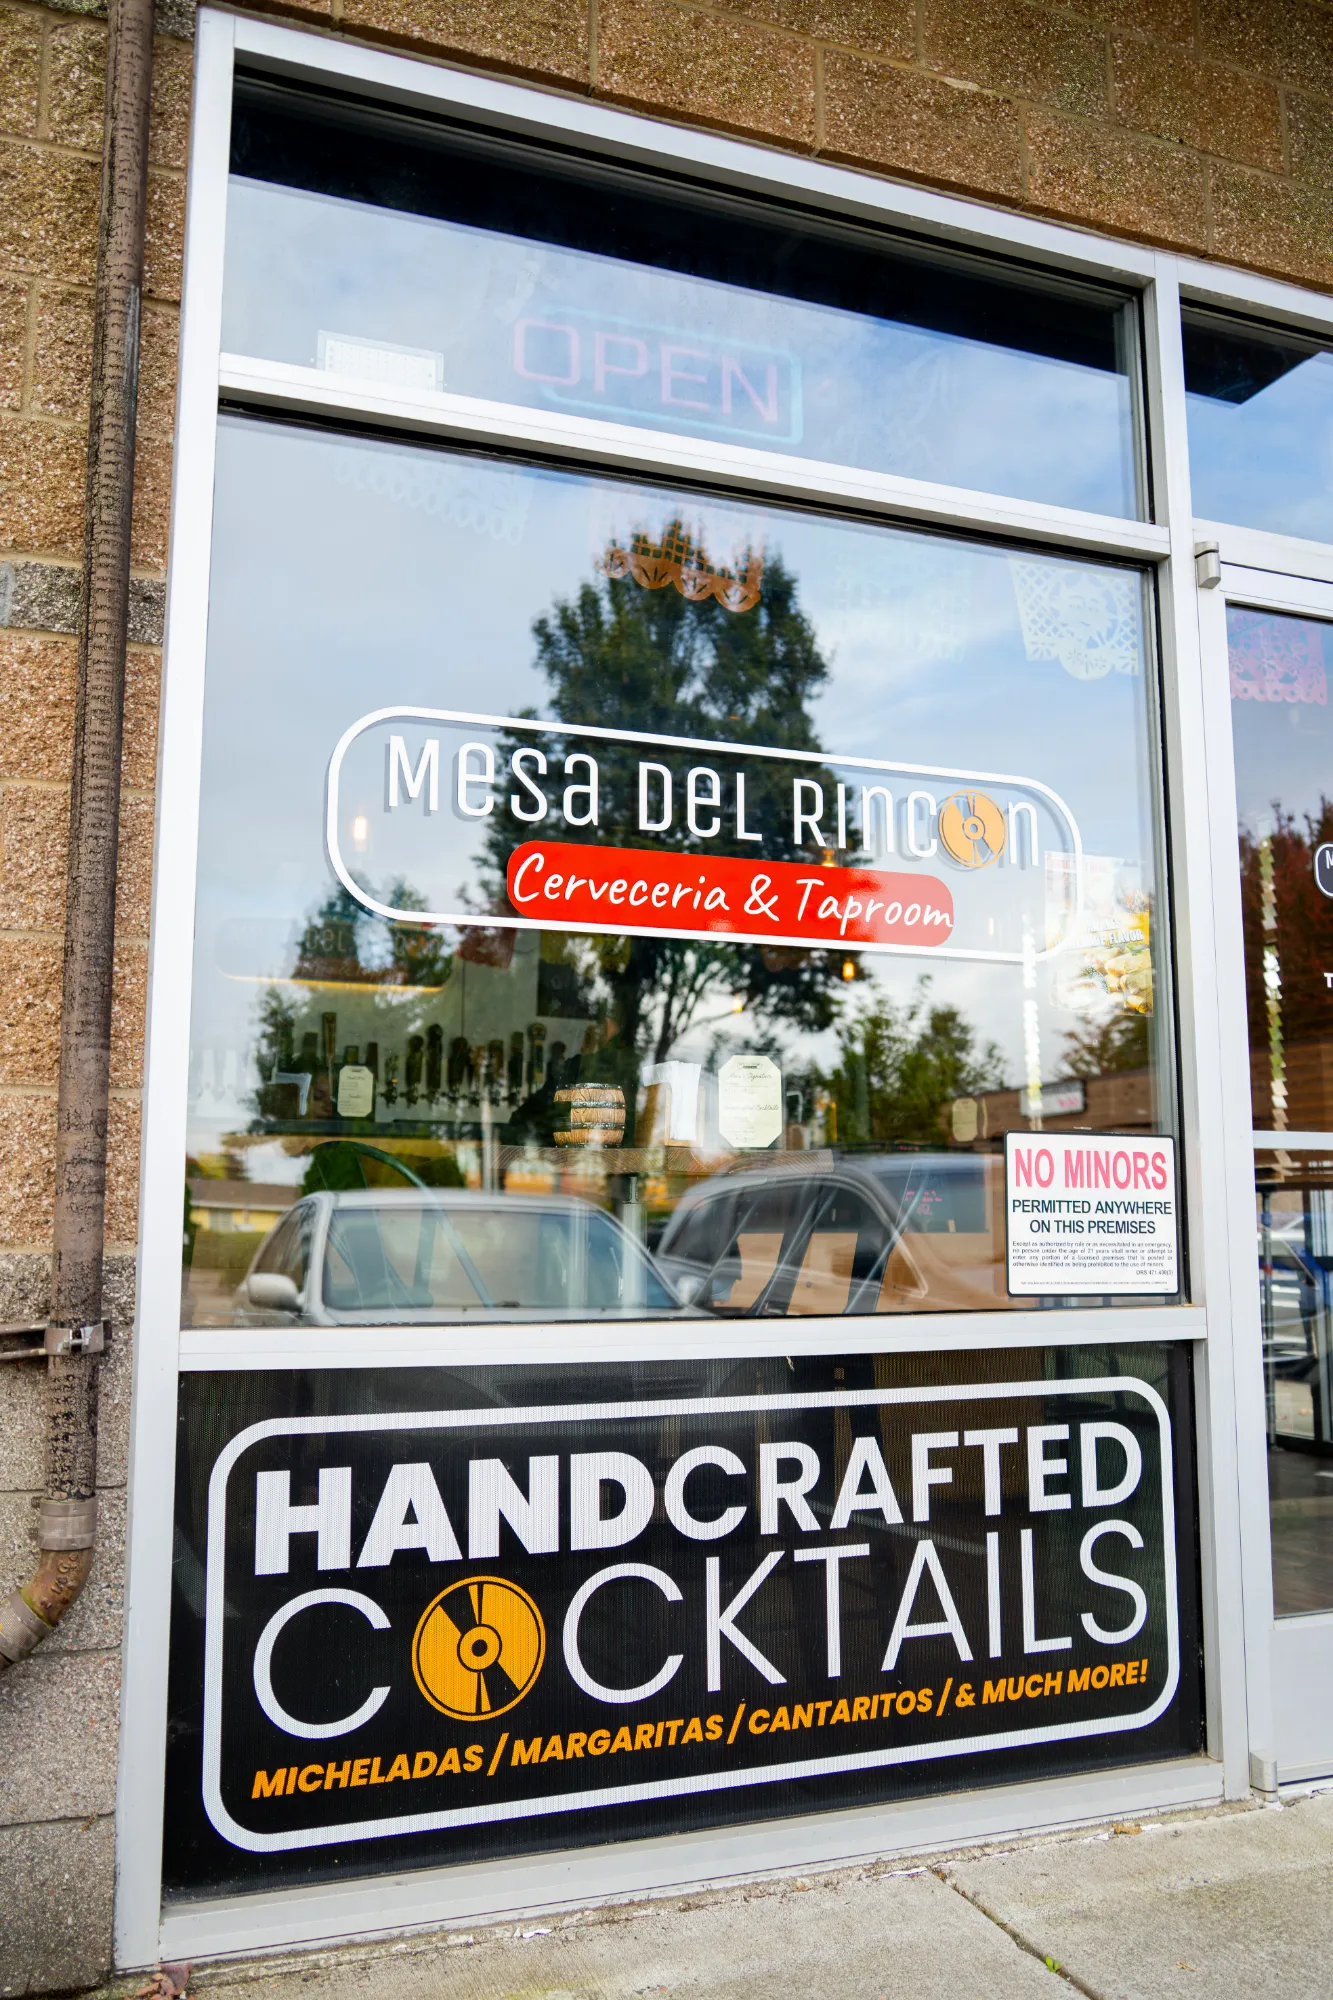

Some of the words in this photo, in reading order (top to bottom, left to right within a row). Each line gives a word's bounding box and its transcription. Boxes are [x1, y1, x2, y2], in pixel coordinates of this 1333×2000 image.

[513, 318, 778, 424] OPEN
[513, 851, 730, 911] Cerveceria
[743, 873, 780, 922] &
[796, 878, 953, 935] Taproom
[1109, 928, 1144, 945] FLAVOR
[1015, 1149, 1055, 1188] NO
[1064, 1149, 1167, 1190] MINORS
[1012, 1199, 1091, 1214] PERMITTED
[1095, 1201, 1172, 1215] ANYWHERE
[1030, 1219, 1050, 1233] ON
[1054, 1220, 1084, 1233] THIS
[1088, 1221, 1156, 1234] PREMISES
[255, 1421, 1143, 1576] HANDCRAFTED
[251, 1744, 484, 1799] MICHELADAS
[511, 1714, 723, 1767] MARGARITAS
[748, 1687, 933, 1735] CANTARITOS
[982, 1671, 1063, 1704] MUCH
[1067, 1658, 1149, 1692] MORE!
